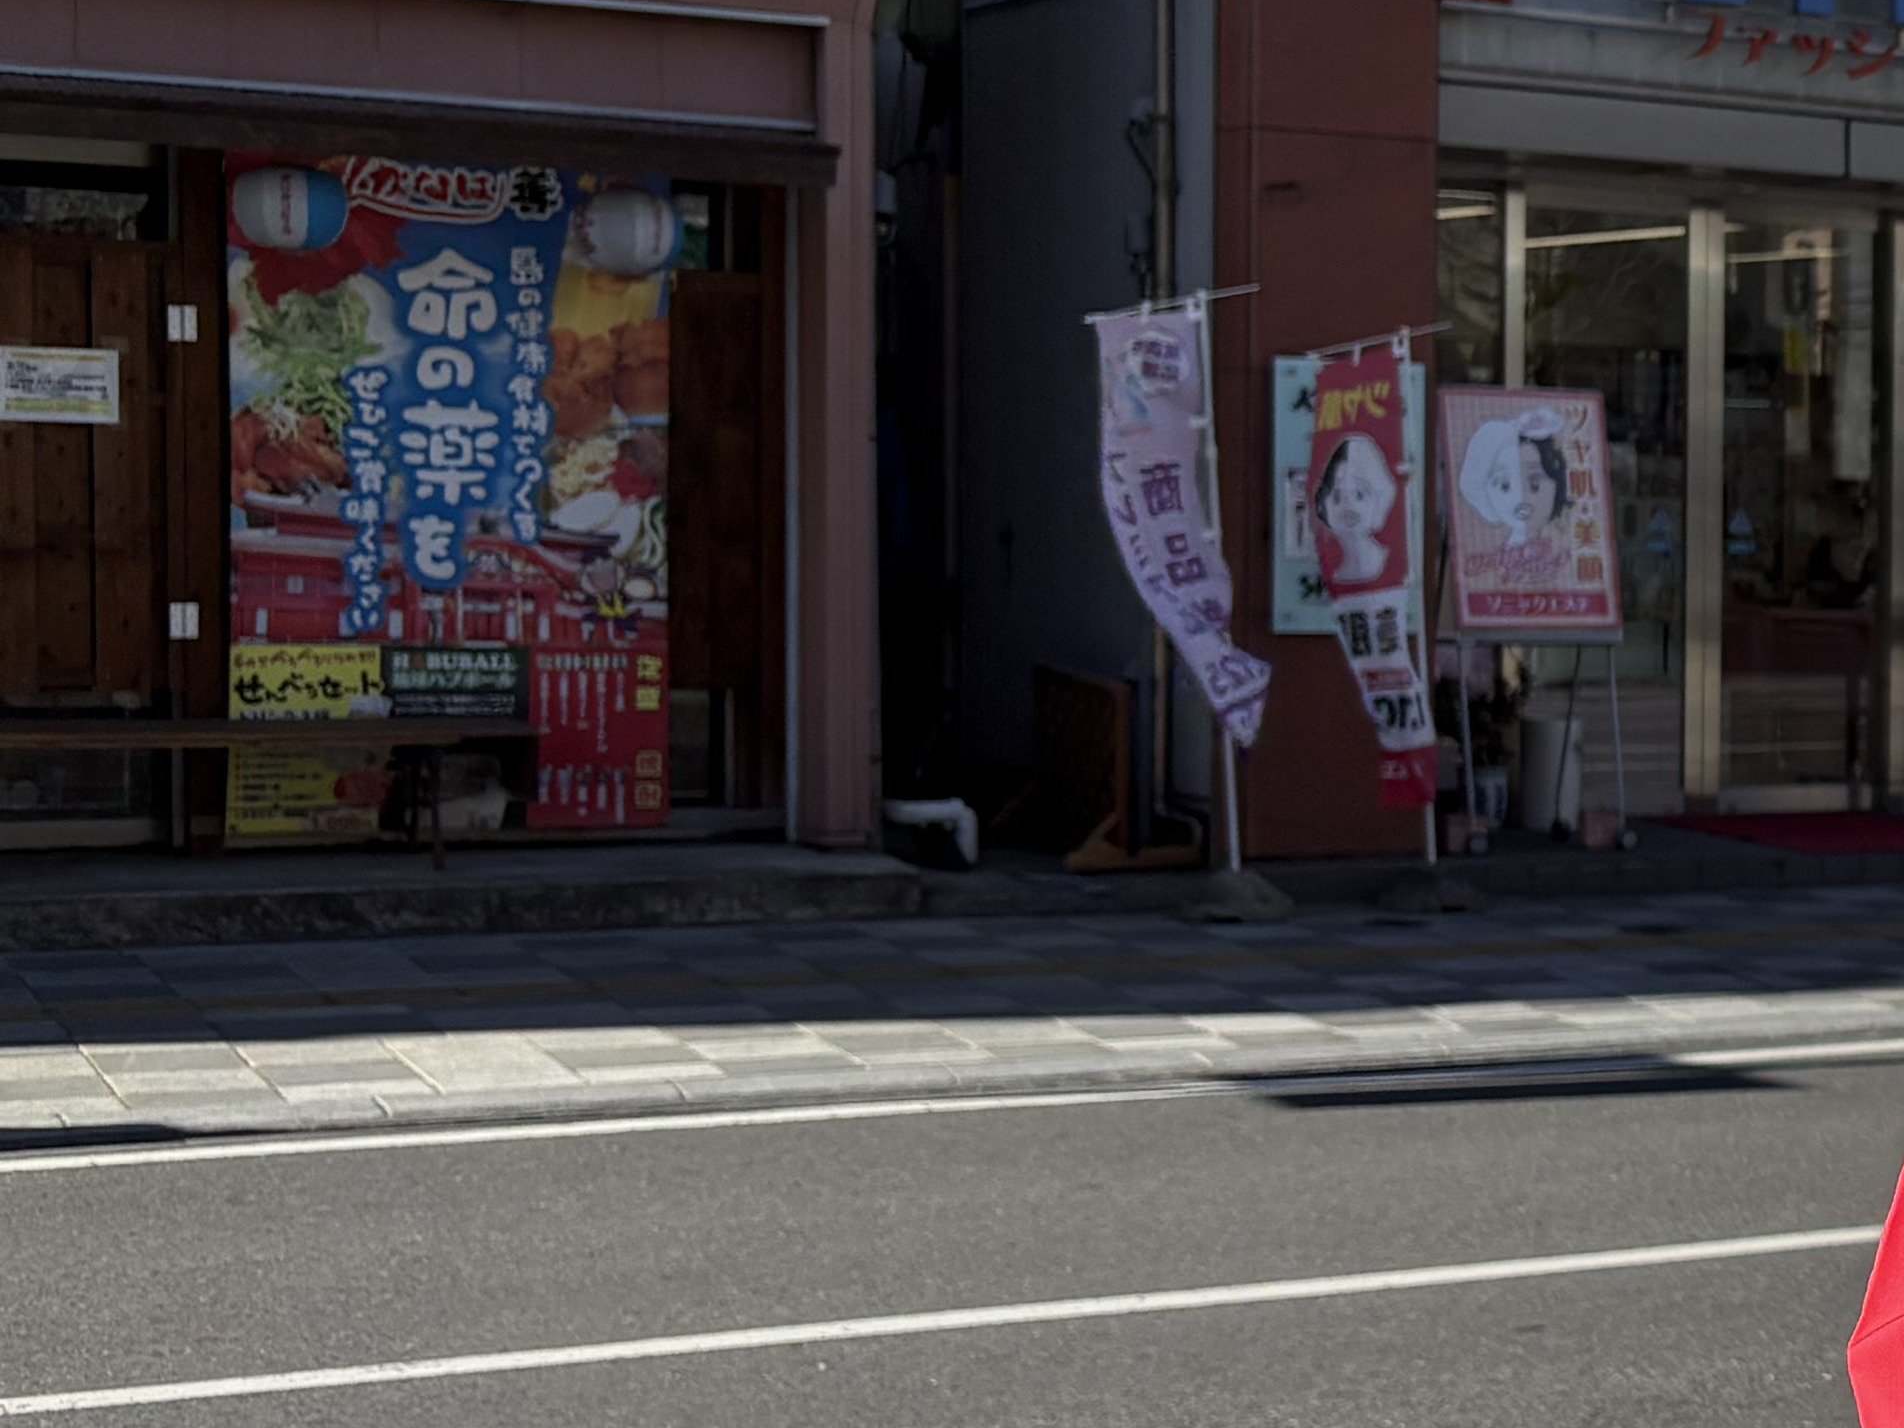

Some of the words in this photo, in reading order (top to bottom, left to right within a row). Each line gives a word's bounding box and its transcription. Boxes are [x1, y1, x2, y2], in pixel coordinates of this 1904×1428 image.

[396, 246, 501, 582] 命の薬を
[234, 671, 383, 705] せんべろセット
